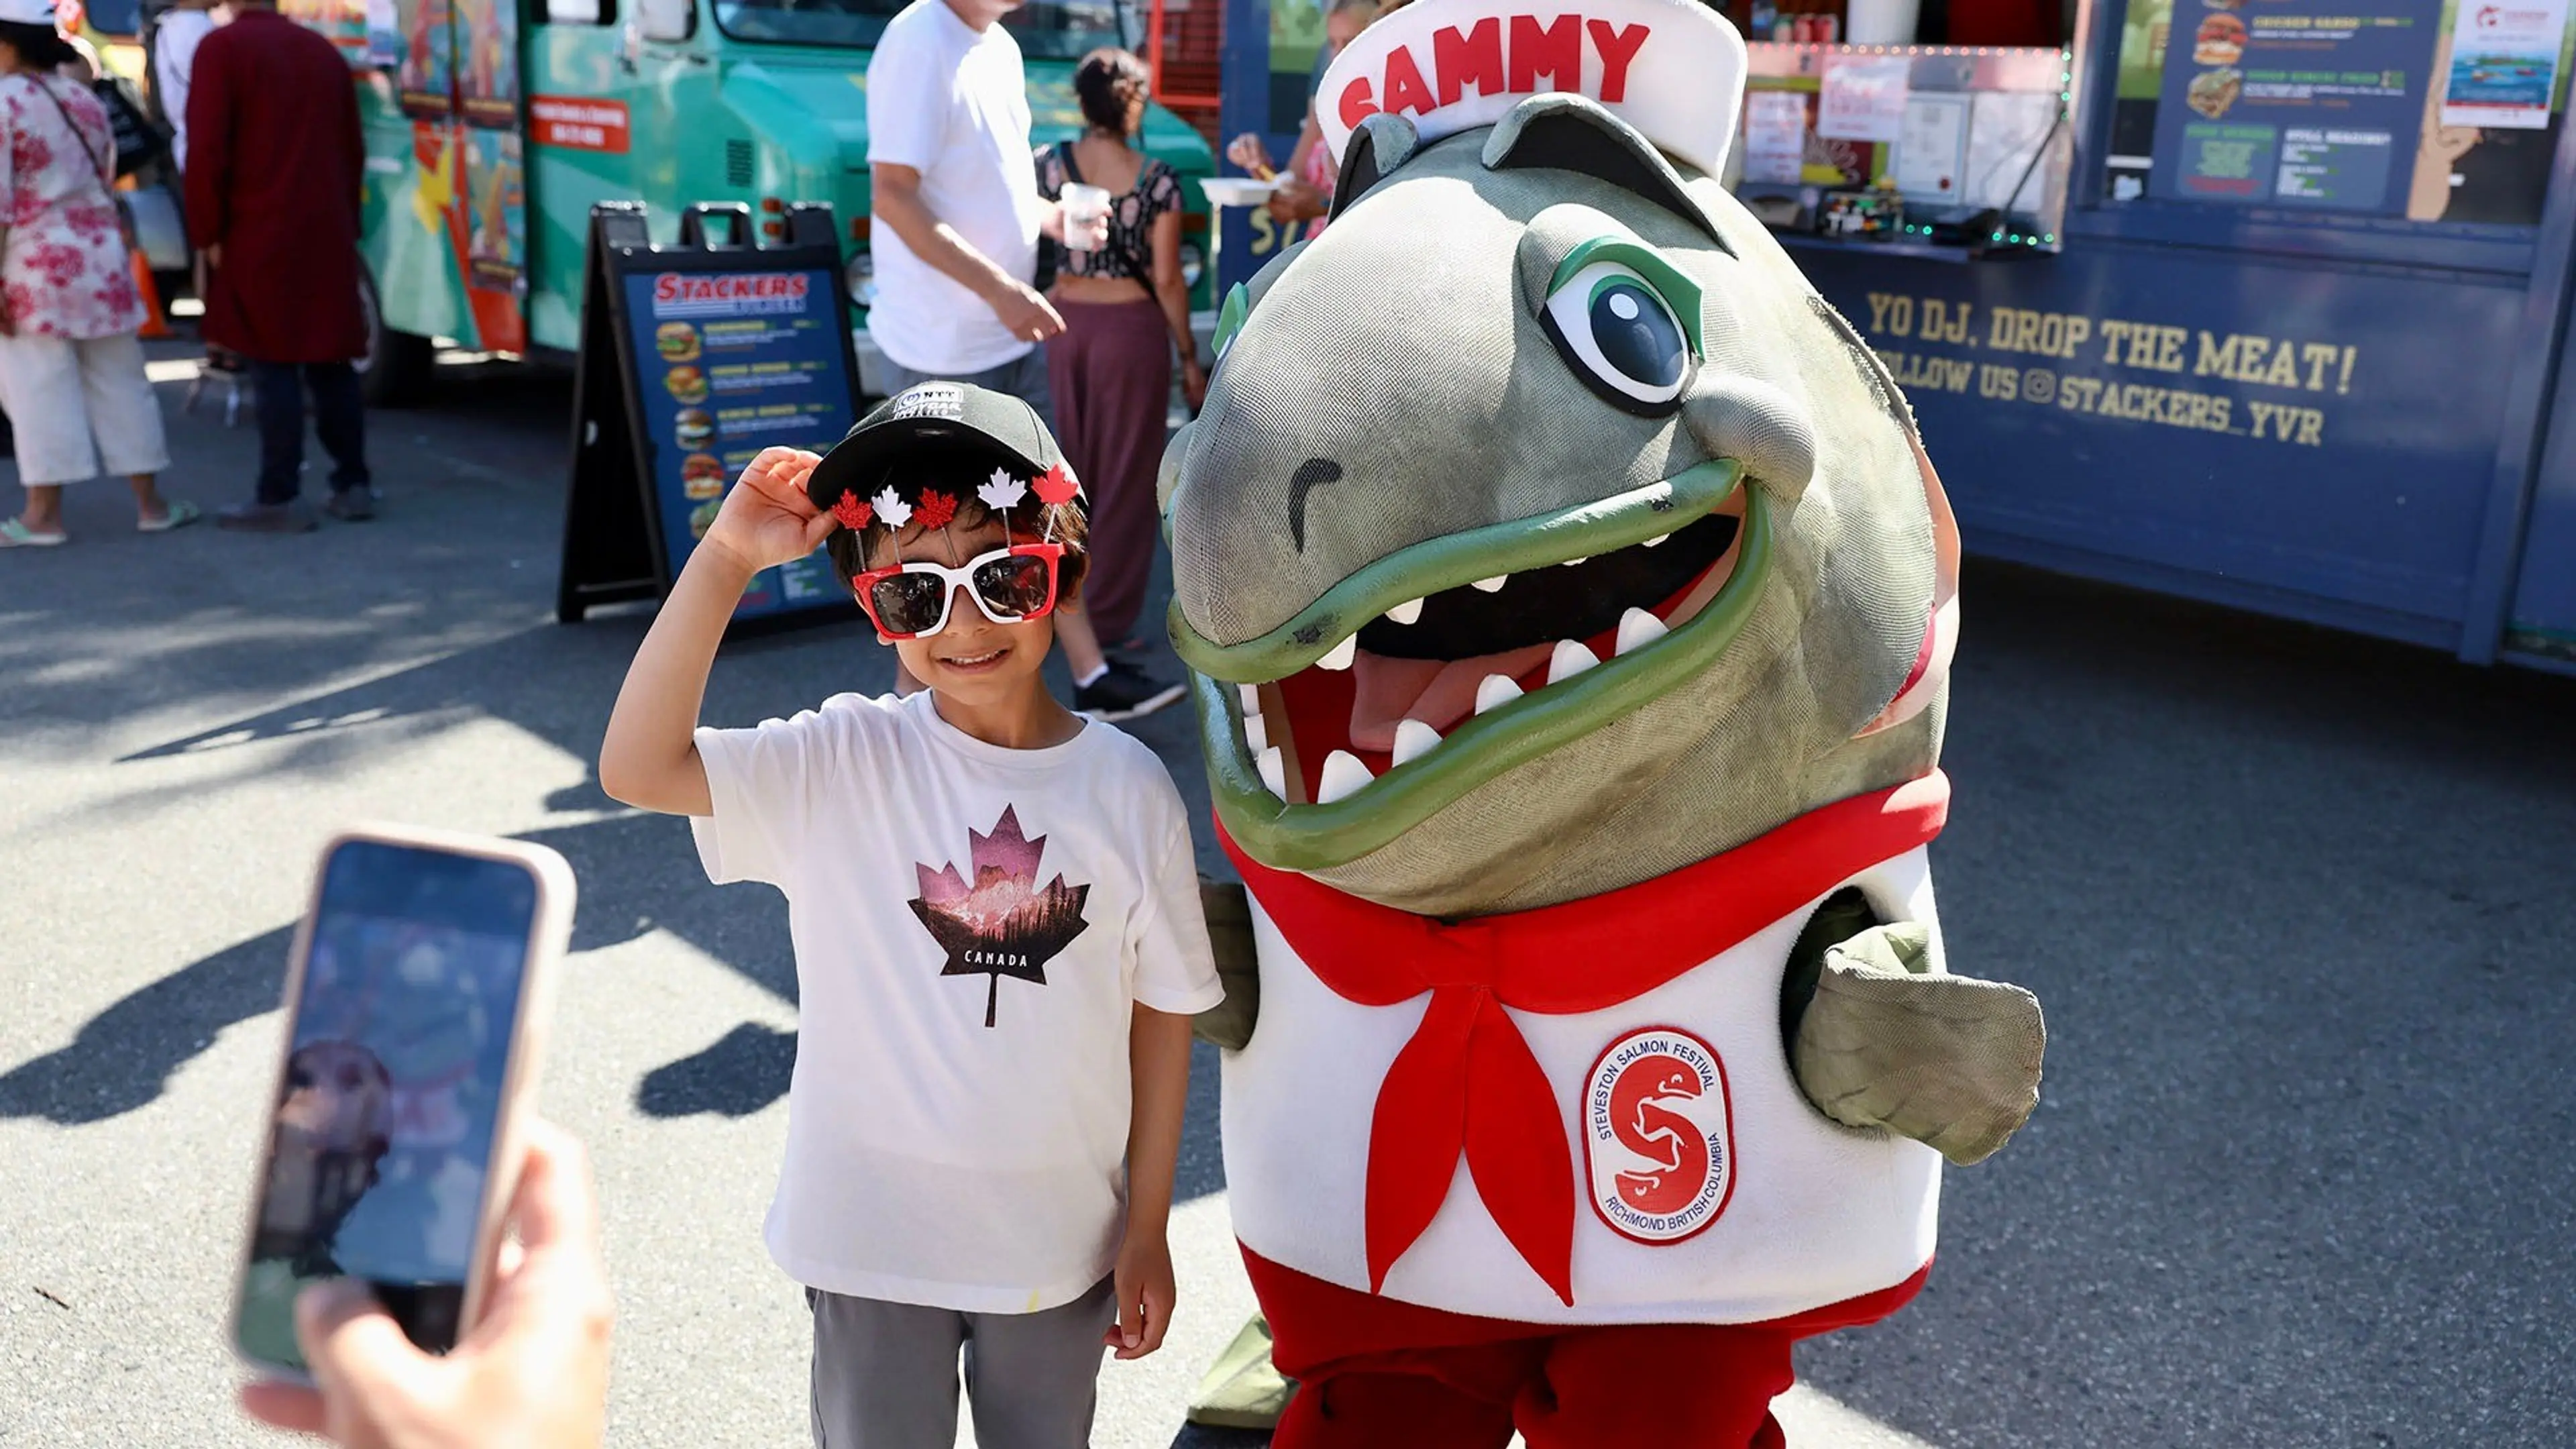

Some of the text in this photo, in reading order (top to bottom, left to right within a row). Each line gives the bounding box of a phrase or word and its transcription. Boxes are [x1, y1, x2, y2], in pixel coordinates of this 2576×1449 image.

[1338, 14, 1651, 131] SAMMY
[656, 273, 810, 302] STACKERS
[1868, 292, 1913, 336] YO
[1988, 307, 2091, 358] DROP
[2100, 317, 2188, 372] THE
[2193, 331, 2357, 394] MEAT!
[1876, 349, 1974, 394] OLLOW
[1980, 364, 2021, 400] US
[964, 950, 1028, 967] CANADA
[1595, 1040, 1715, 1140] STEVESTON SALMON FESTIVAL
[1605, 1132, 1723, 1231] RICHMOND BRITISH COLUMBIA
